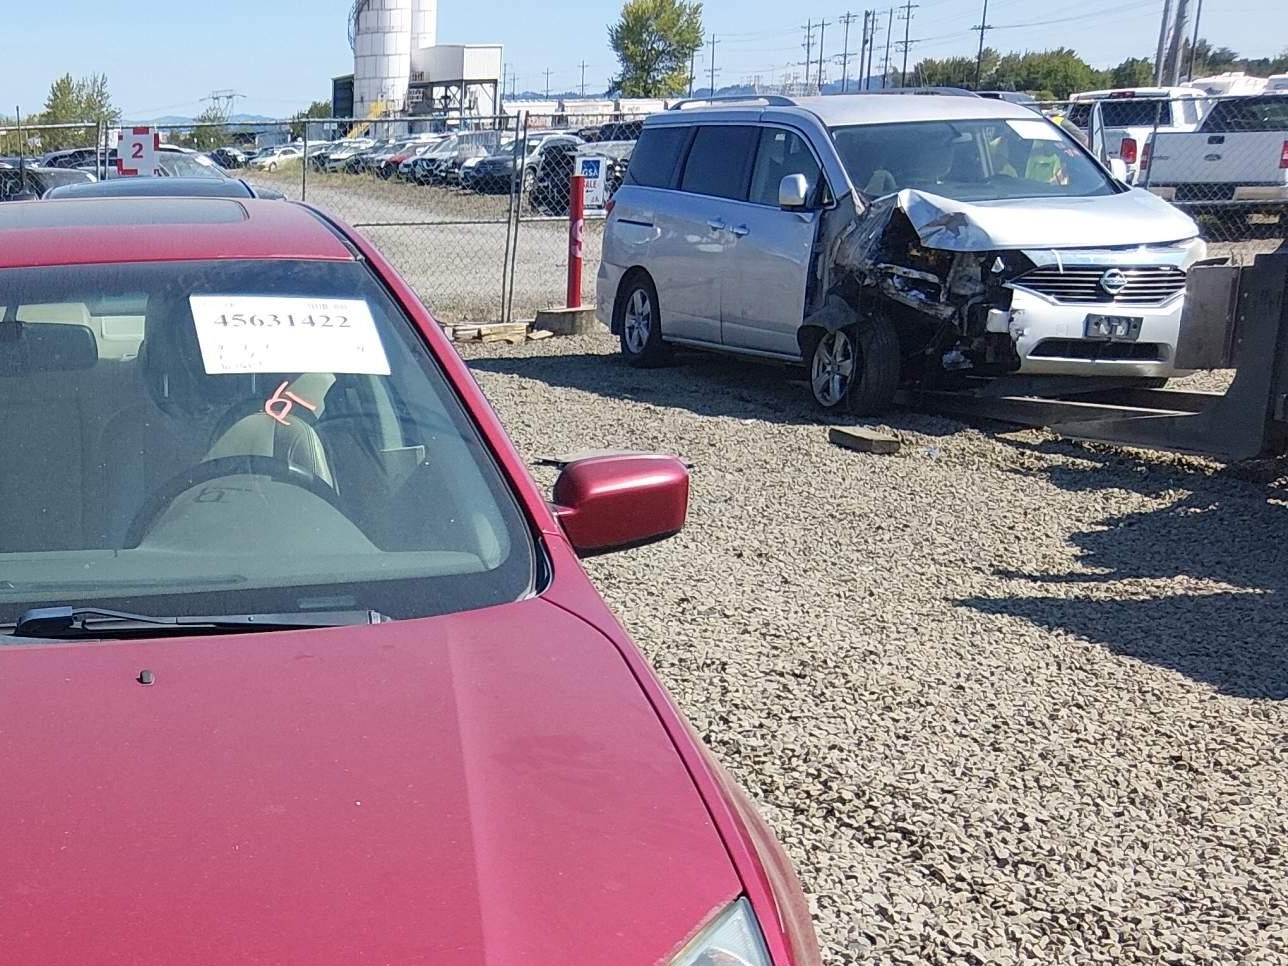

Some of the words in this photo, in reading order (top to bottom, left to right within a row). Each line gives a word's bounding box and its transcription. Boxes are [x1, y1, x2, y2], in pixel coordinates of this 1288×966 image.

[131, 143, 143, 158] 2
[583, 180, 597, 188] ALE
[213, 313, 352, 328] 45631422
